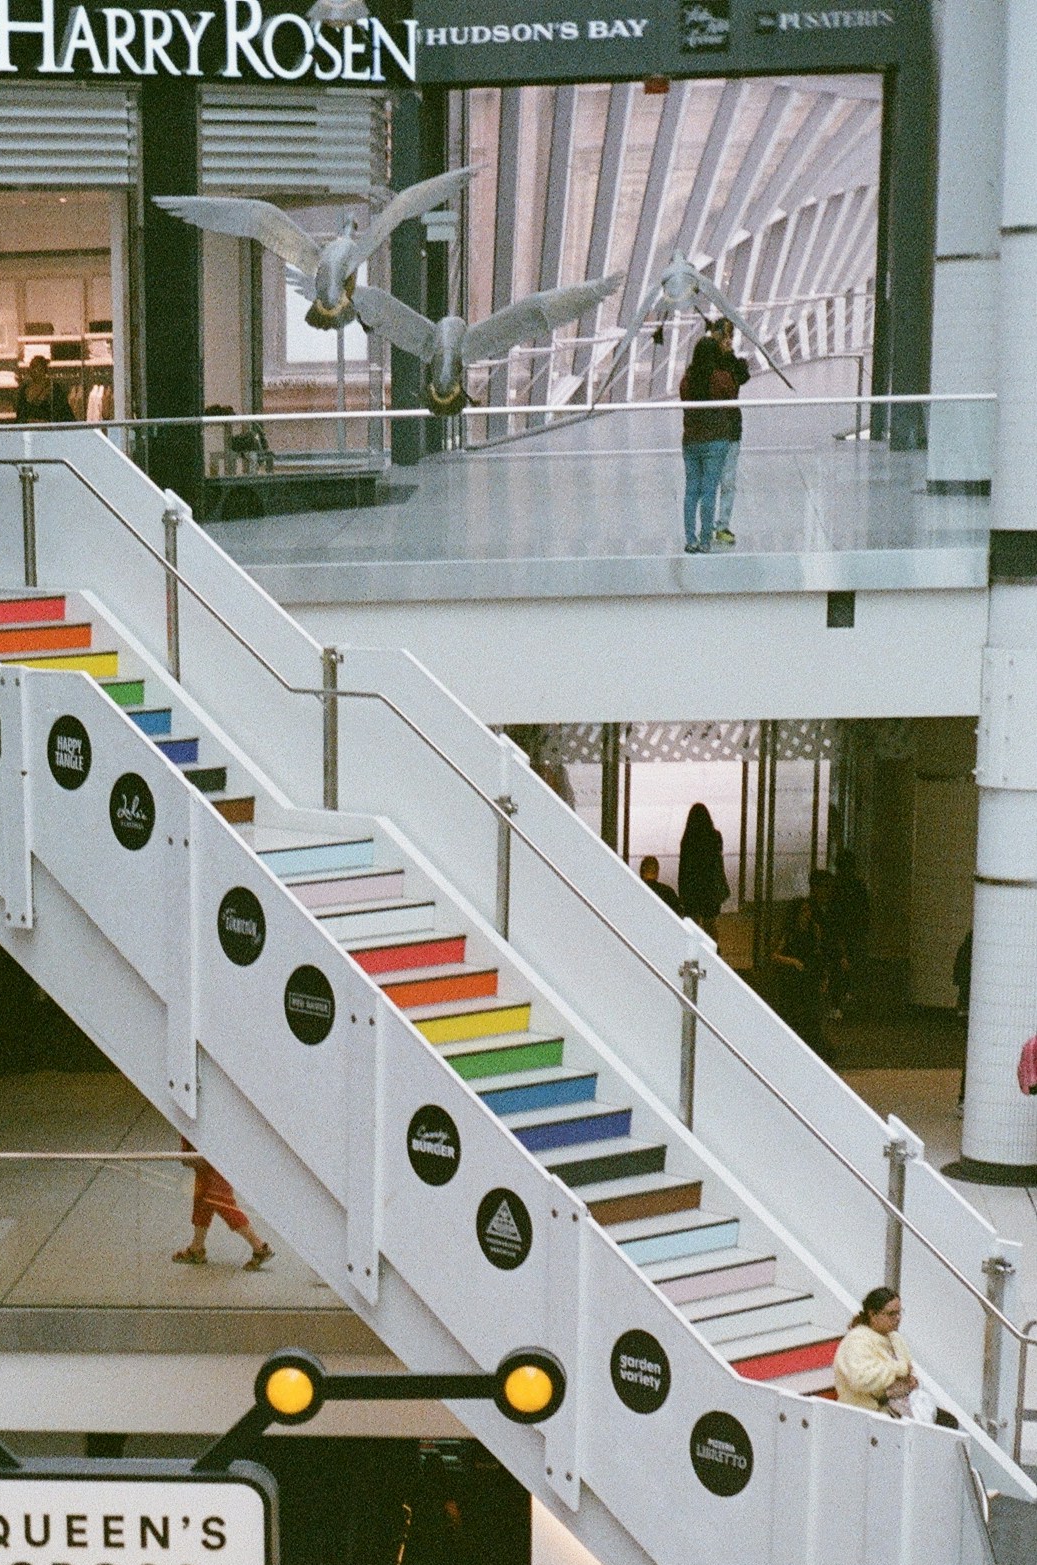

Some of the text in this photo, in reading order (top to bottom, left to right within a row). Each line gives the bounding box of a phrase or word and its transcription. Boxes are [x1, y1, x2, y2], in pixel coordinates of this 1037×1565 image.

[222, 0, 418, 81] ROSEN
[425, 19, 648, 46] HUDSON'S BAY
[57, 735, 82, 755] HAPPY
[55, 751, 84, 772] TANGLE
[412, 1138, 455, 1160] BURGER
[619, 1354, 661, 1375] garden
[620, 1369, 661, 1392] variety
[695, 1443, 747, 1470] LIBRETTO
